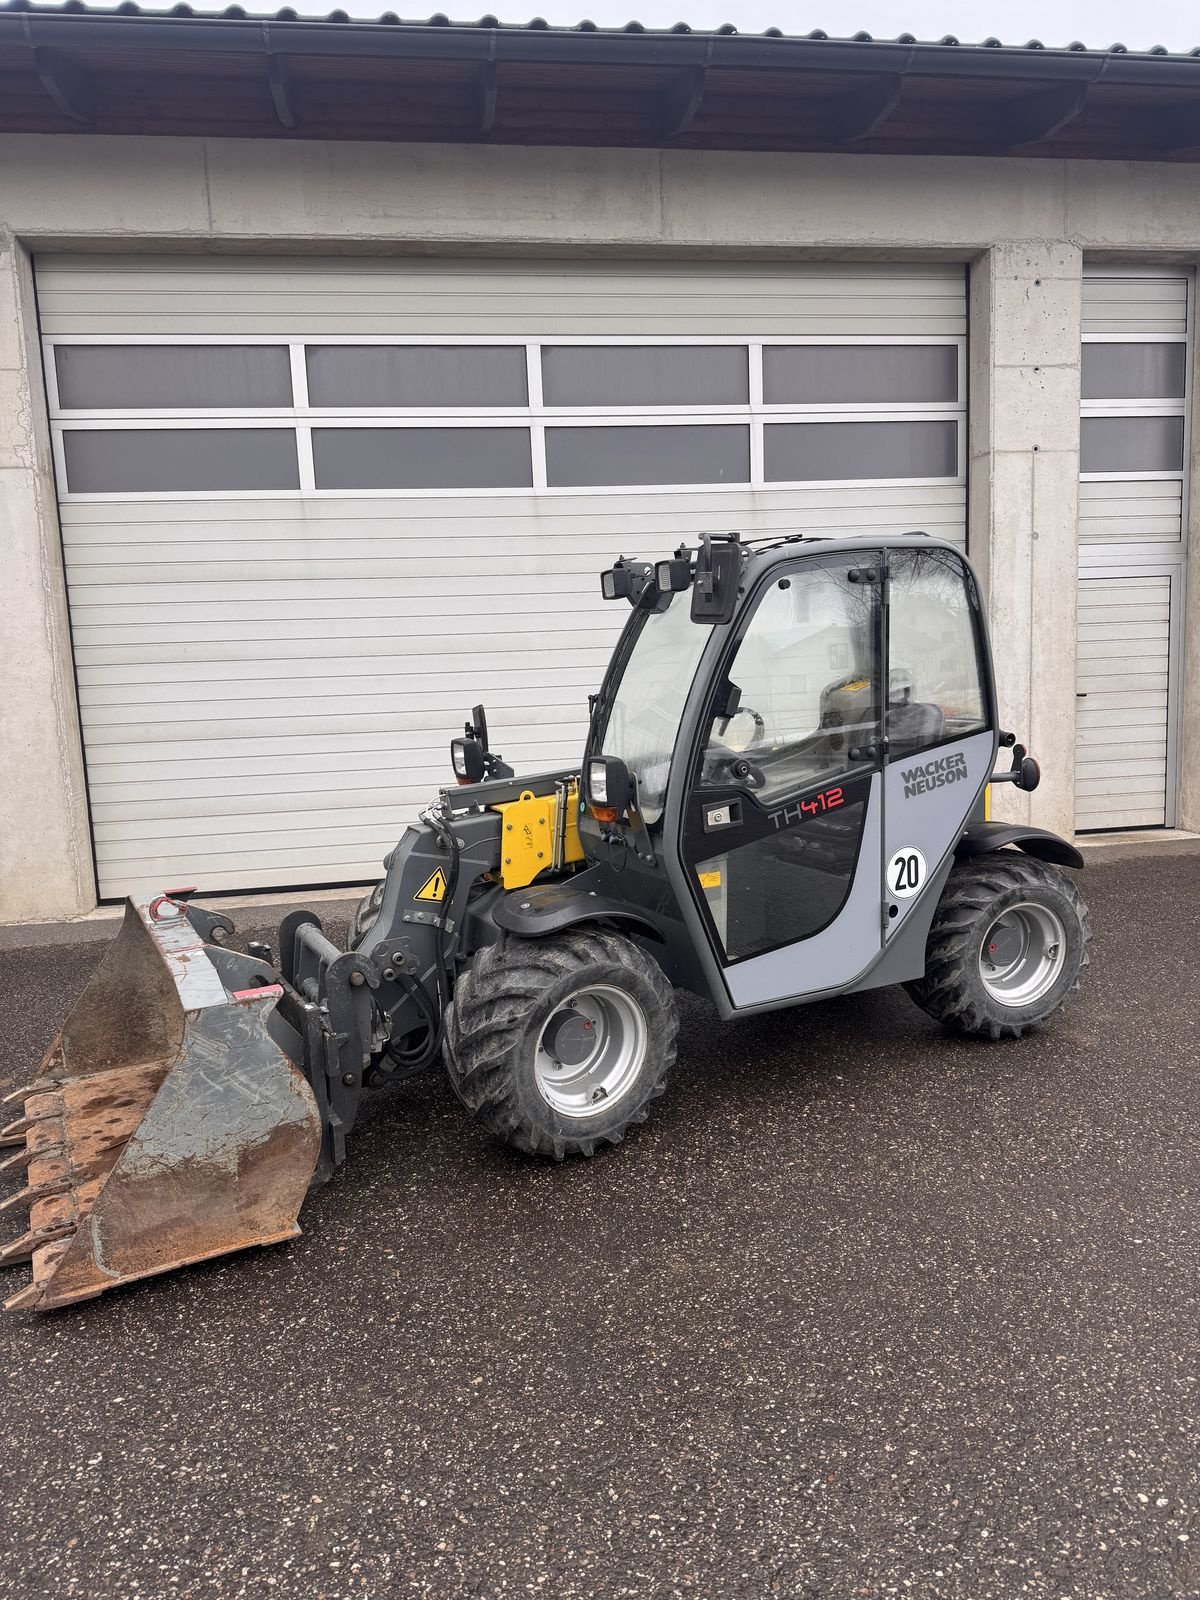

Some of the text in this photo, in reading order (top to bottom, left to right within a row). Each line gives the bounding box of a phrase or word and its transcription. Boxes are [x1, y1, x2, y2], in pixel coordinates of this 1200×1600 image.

[900, 751, 966, 785] WACKER
[903, 764, 968, 799] NEUSON
[767, 787, 845, 829] TH412
[894, 855, 919, 892] 20
